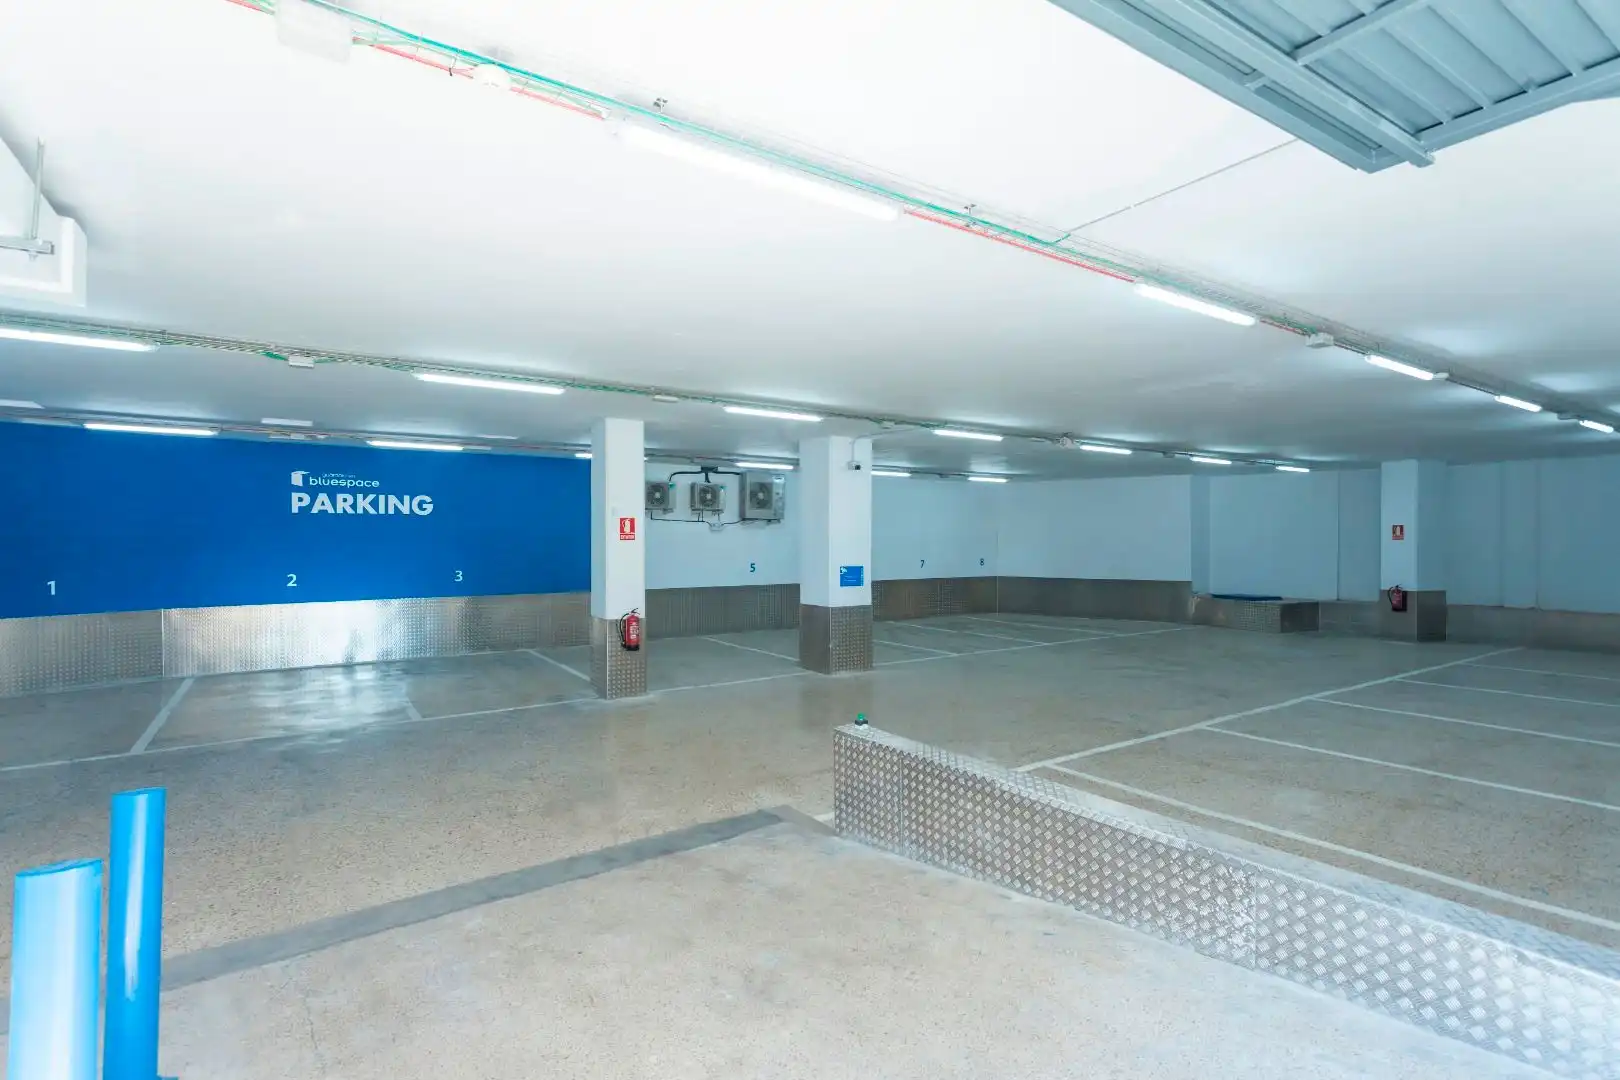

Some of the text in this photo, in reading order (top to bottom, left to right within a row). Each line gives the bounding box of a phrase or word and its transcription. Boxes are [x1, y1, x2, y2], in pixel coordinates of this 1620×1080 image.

[309, 476, 380, 488] bluespace
[291, 492, 434, 516] PARKING
[749, 562, 756, 573] 5
[920, 560, 925, 569] 7
[286, 573, 298, 587] 2
[454, 570, 463, 582] 3
[47, 580, 56, 596] 1
